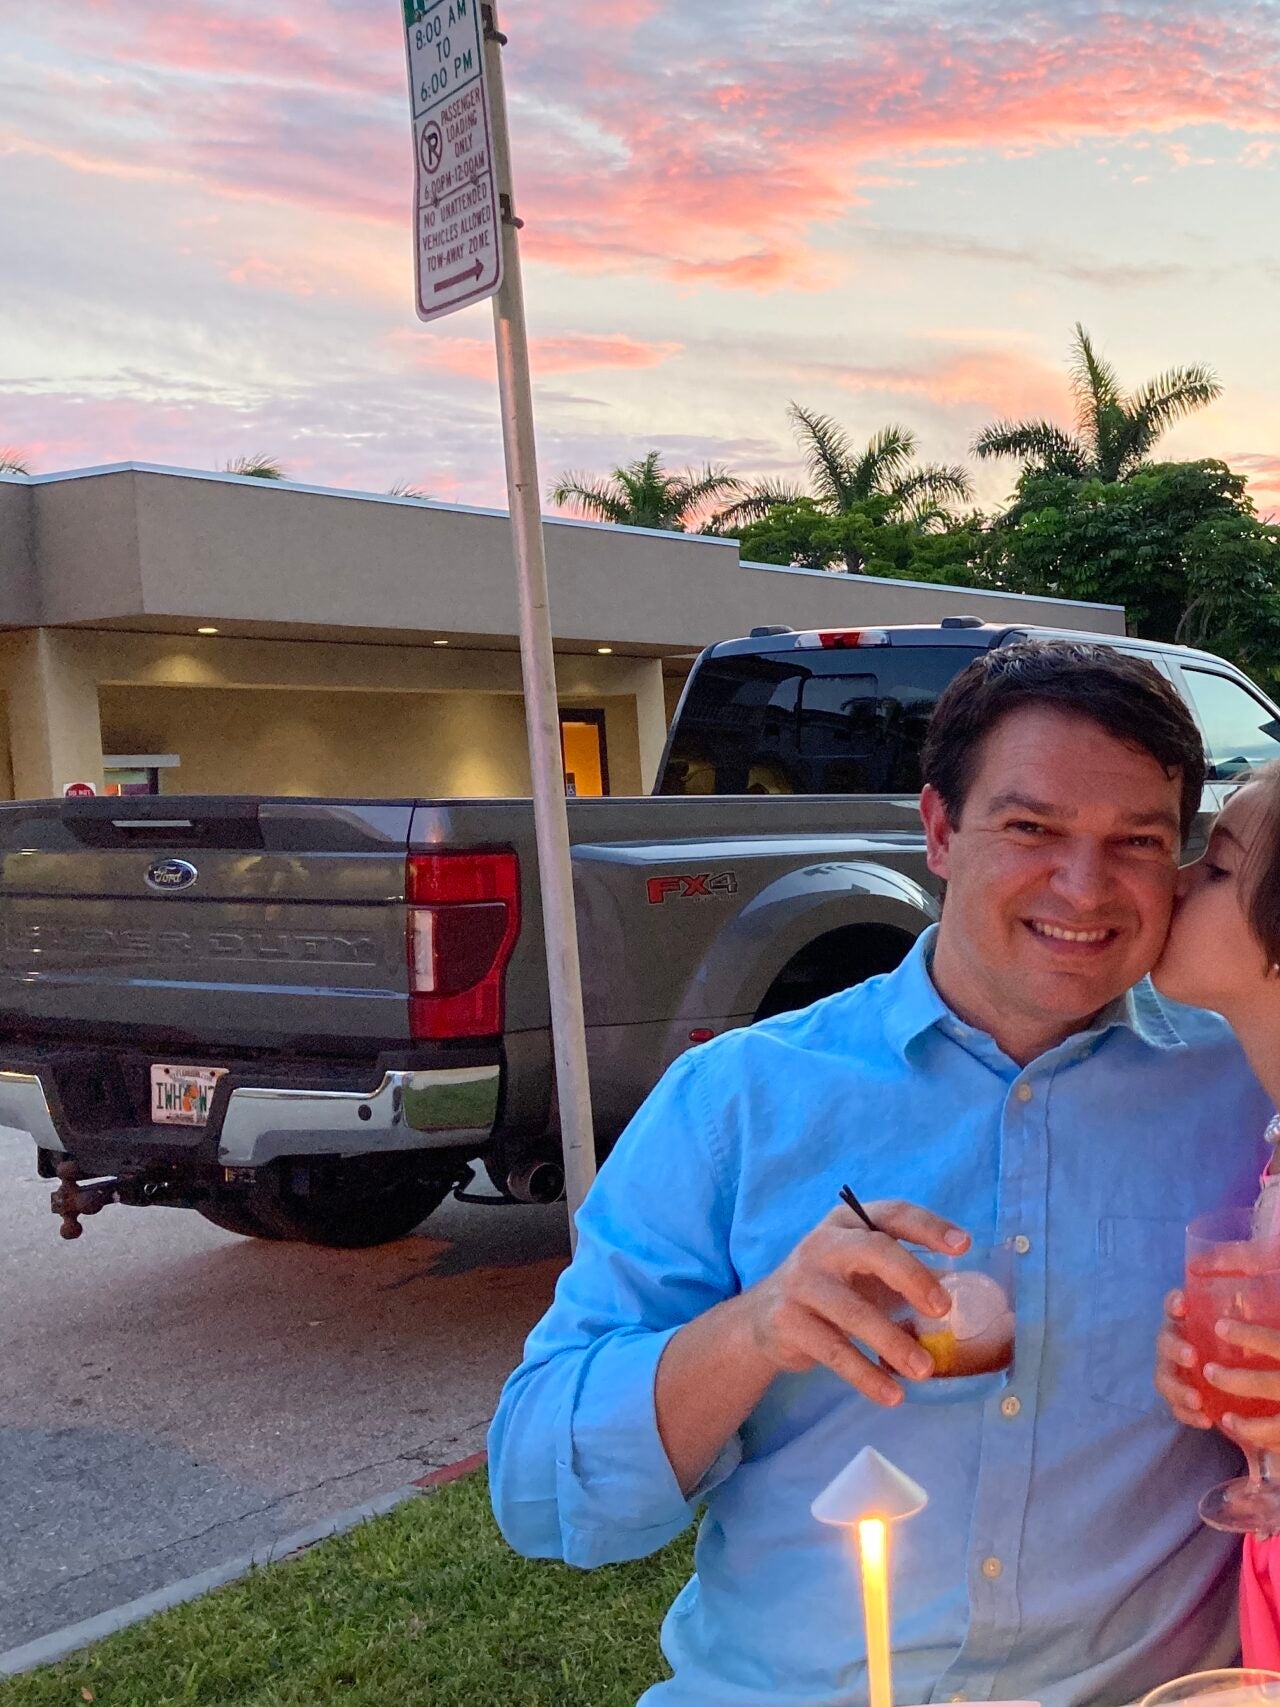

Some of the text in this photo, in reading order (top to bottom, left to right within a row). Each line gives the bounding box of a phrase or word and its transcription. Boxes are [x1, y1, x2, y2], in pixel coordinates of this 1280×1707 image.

[416, 0, 467, 50] 8:00 AM
[436, 36, 451, 63] TO
[421, 48, 473, 102] 6:00 PM
[441, 87, 480, 127] PASSENGER
[446, 109, 478, 143] LOADING
[455, 132, 473, 158] ONLY
[424, 182, 487, 229] NO UNATTENDED
[422, 204, 491, 251] VEHICLES ALLOWED
[427, 229, 490, 273] TOW-AWAY ZONE
[153, 865, 183, 884] Ford
[646, 870, 738, 905] FX4
